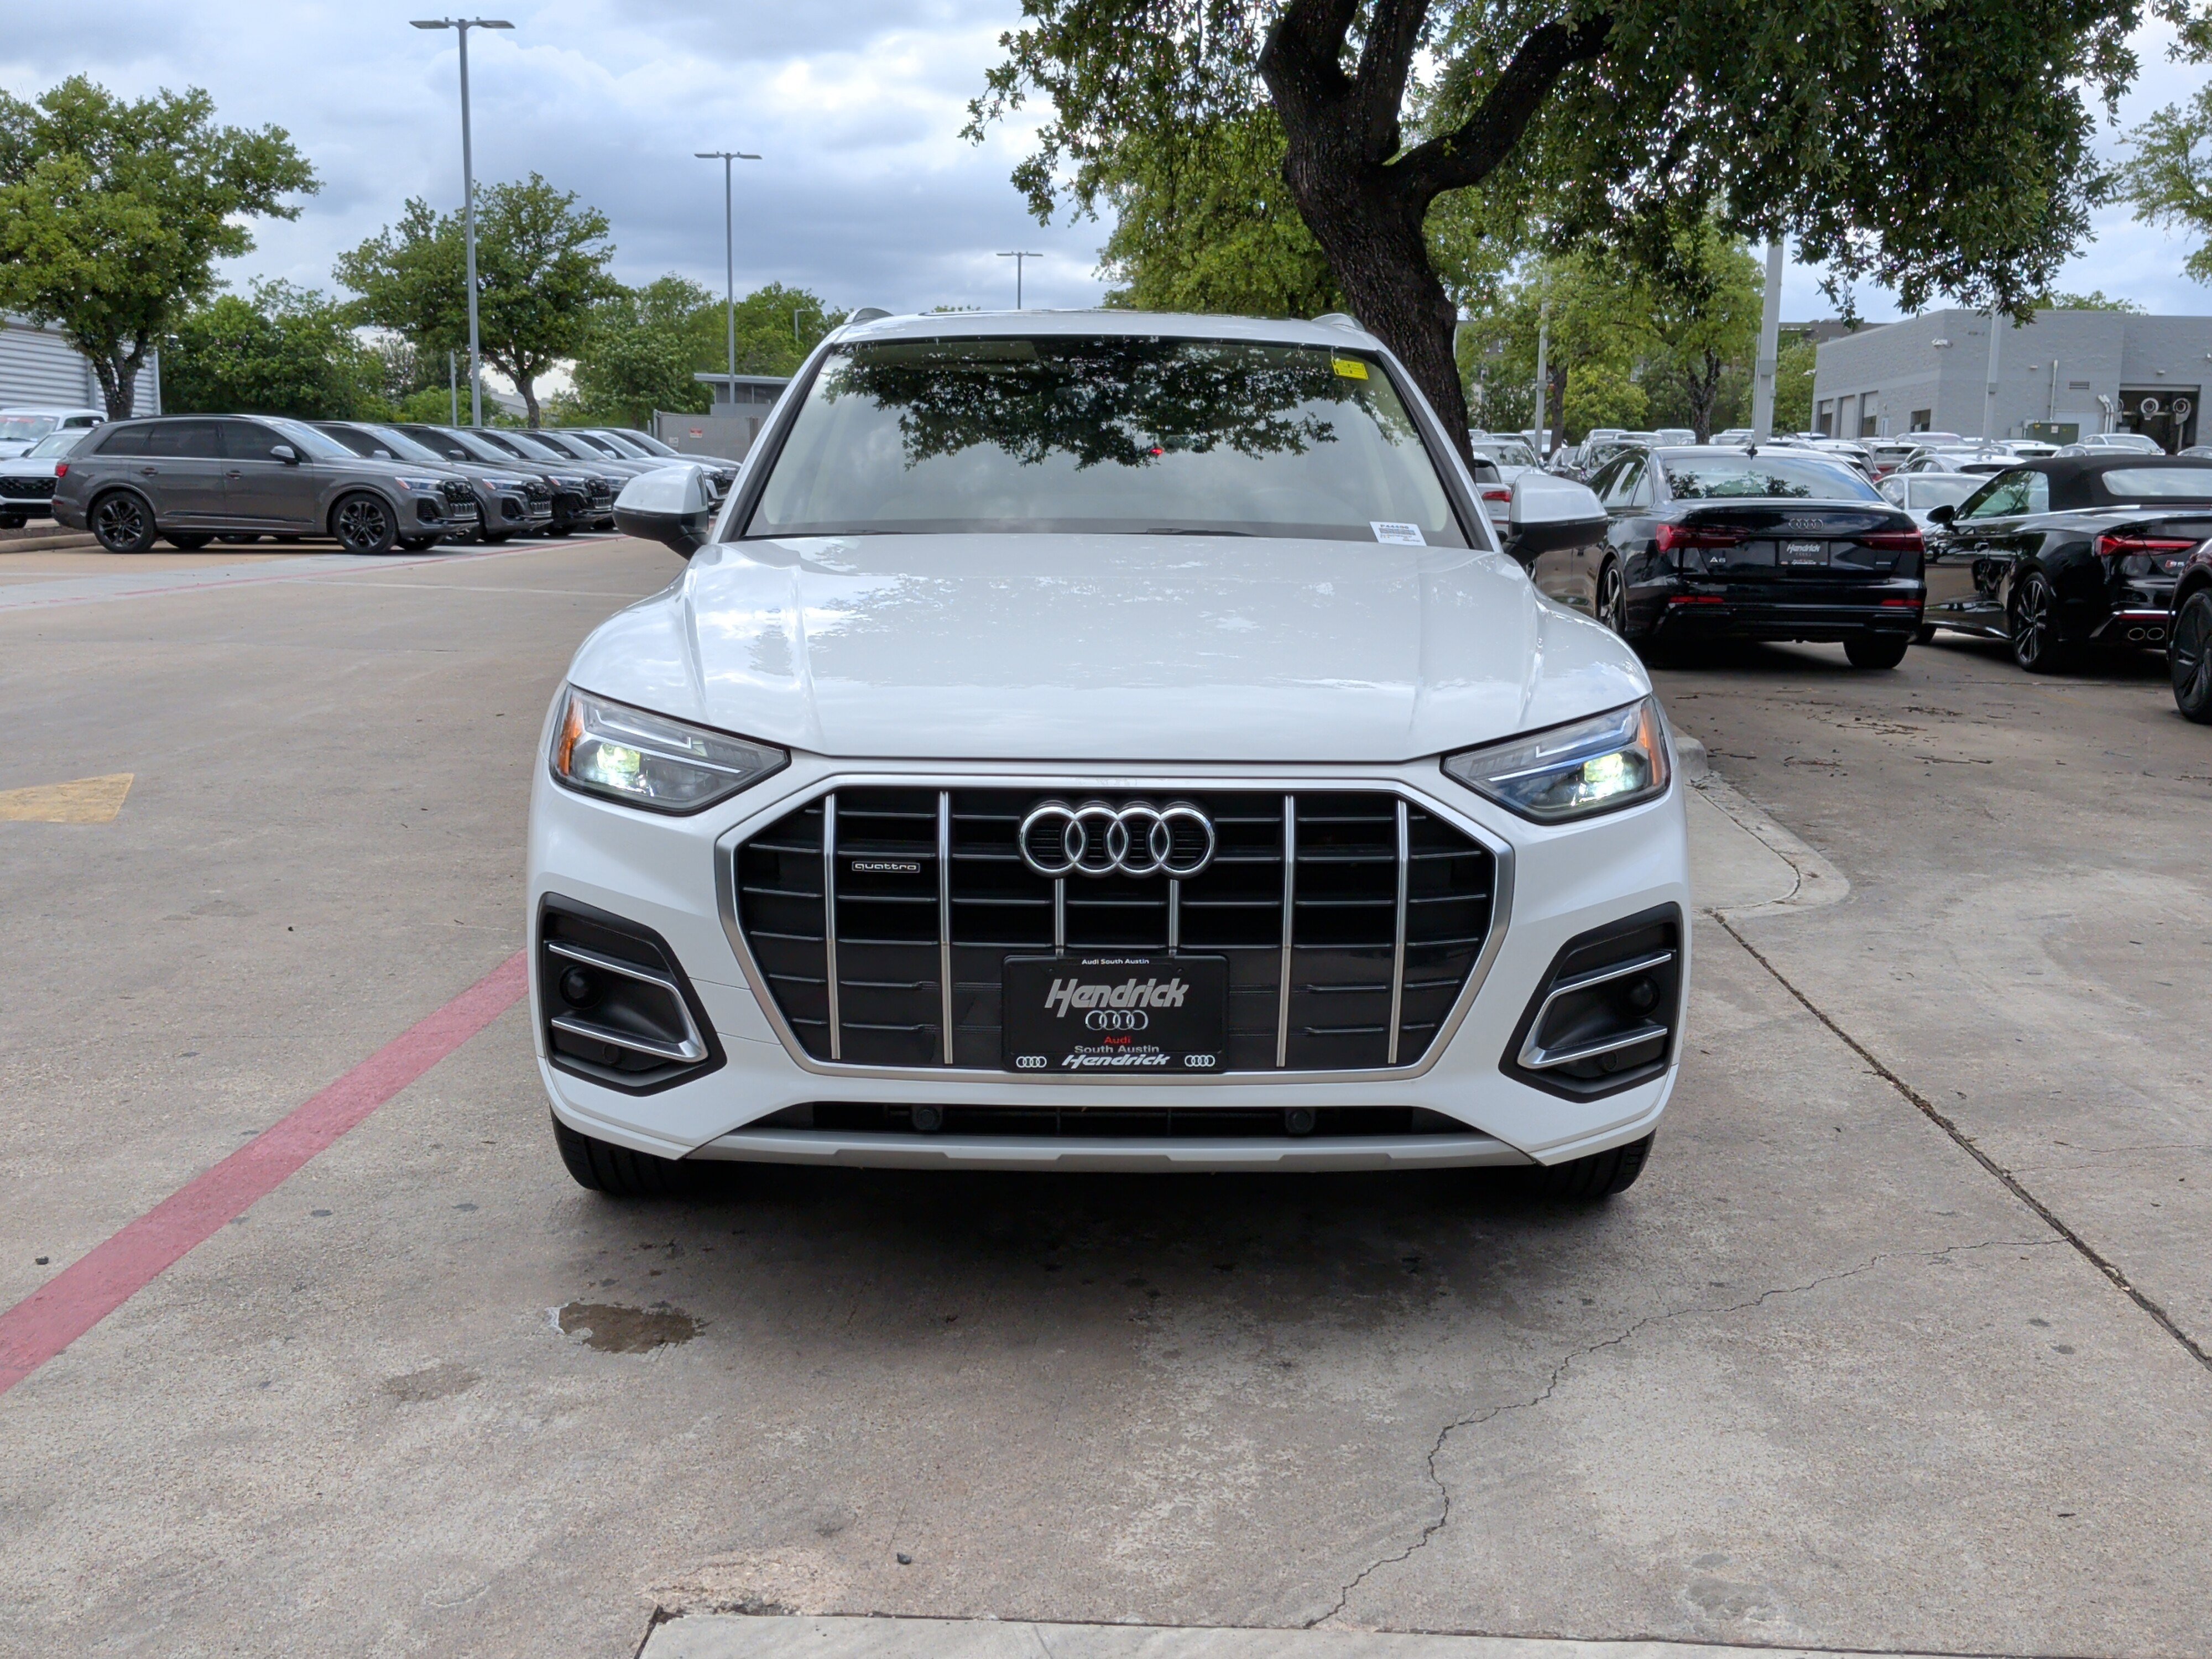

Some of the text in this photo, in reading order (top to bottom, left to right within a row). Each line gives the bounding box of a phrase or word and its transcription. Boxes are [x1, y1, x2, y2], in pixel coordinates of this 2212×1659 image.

[854, 863, 917, 871] quattro
[1044, 978, 1190, 1018] Hendrick
[1104, 1036, 1131, 1044] Audi
[1074, 1045, 1160, 1053] South Austin
[1062, 1053, 1171, 1070] Hendrick
